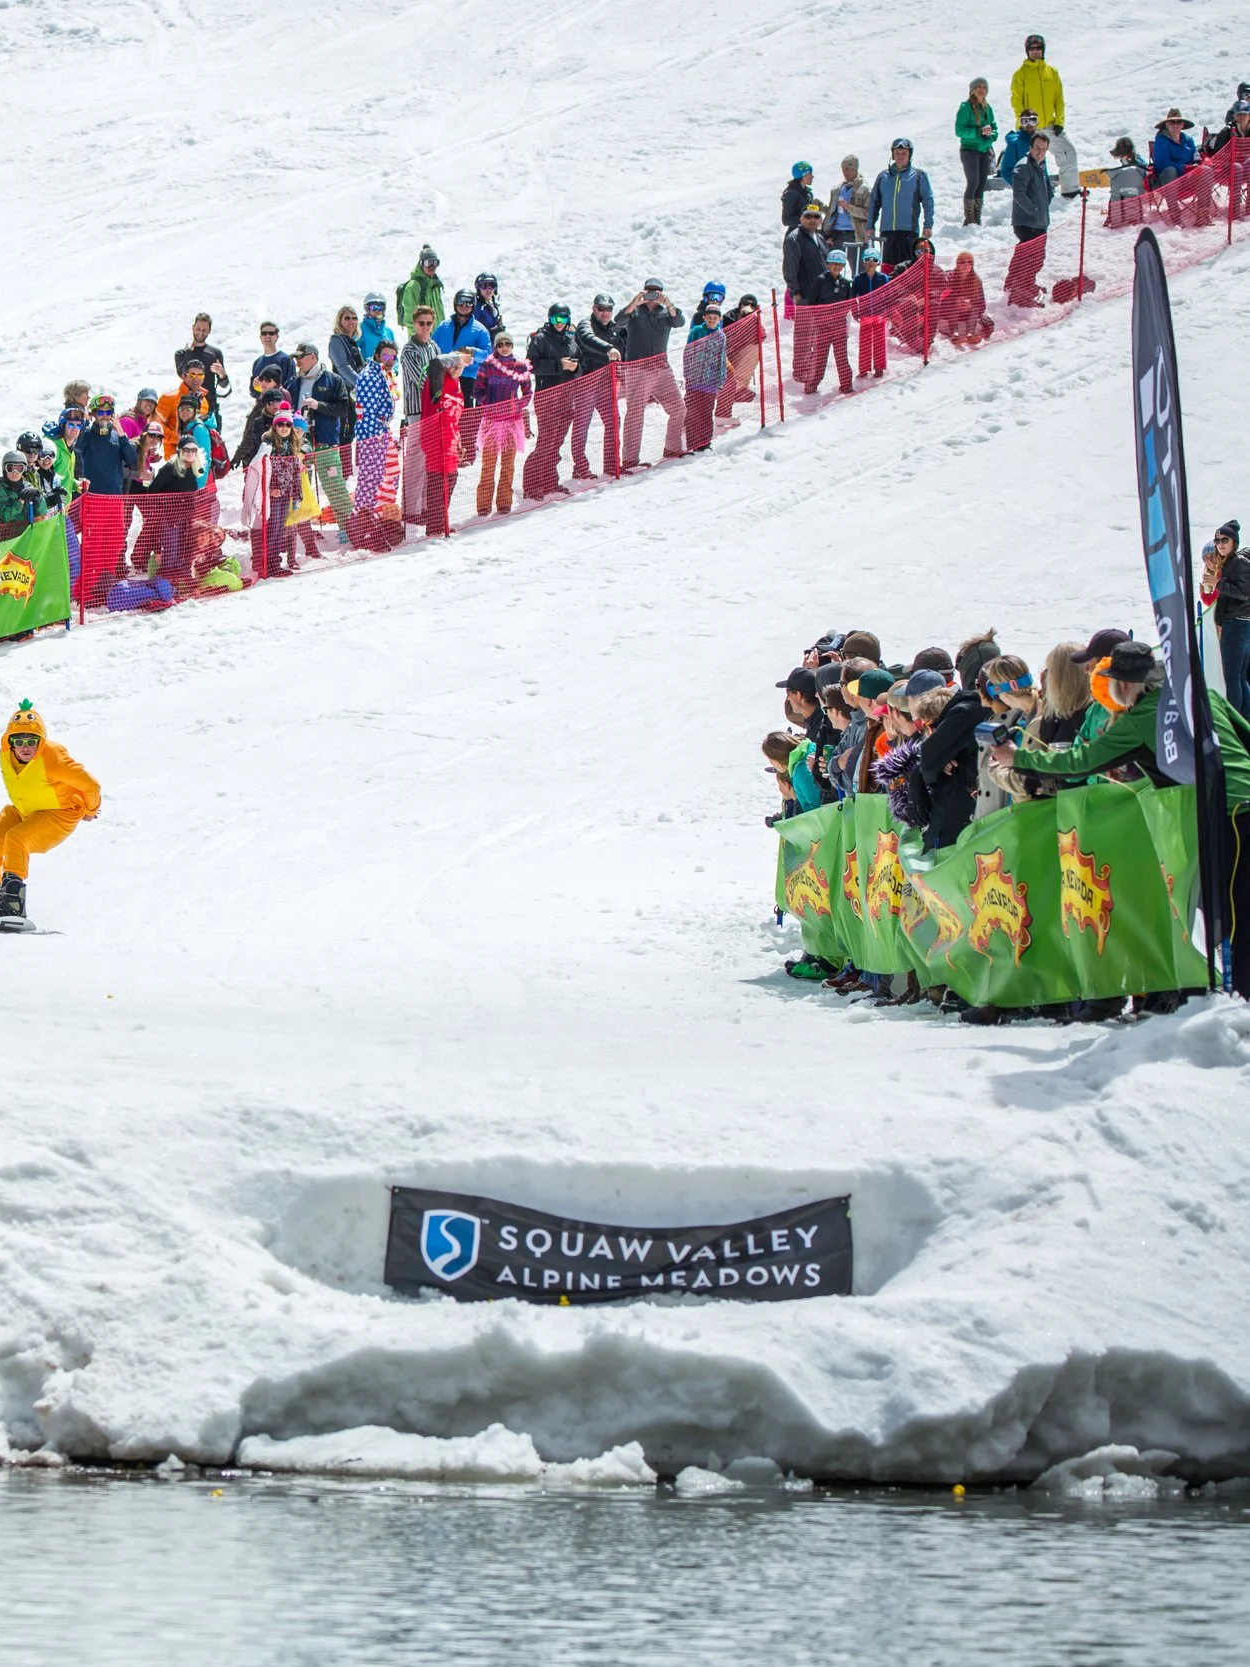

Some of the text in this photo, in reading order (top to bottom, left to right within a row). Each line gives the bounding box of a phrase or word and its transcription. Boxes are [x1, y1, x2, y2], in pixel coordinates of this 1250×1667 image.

[498, 1225, 819, 1264] SQUAW VALLEY
[496, 1263, 821, 1291] ALPINE MEADOWS
